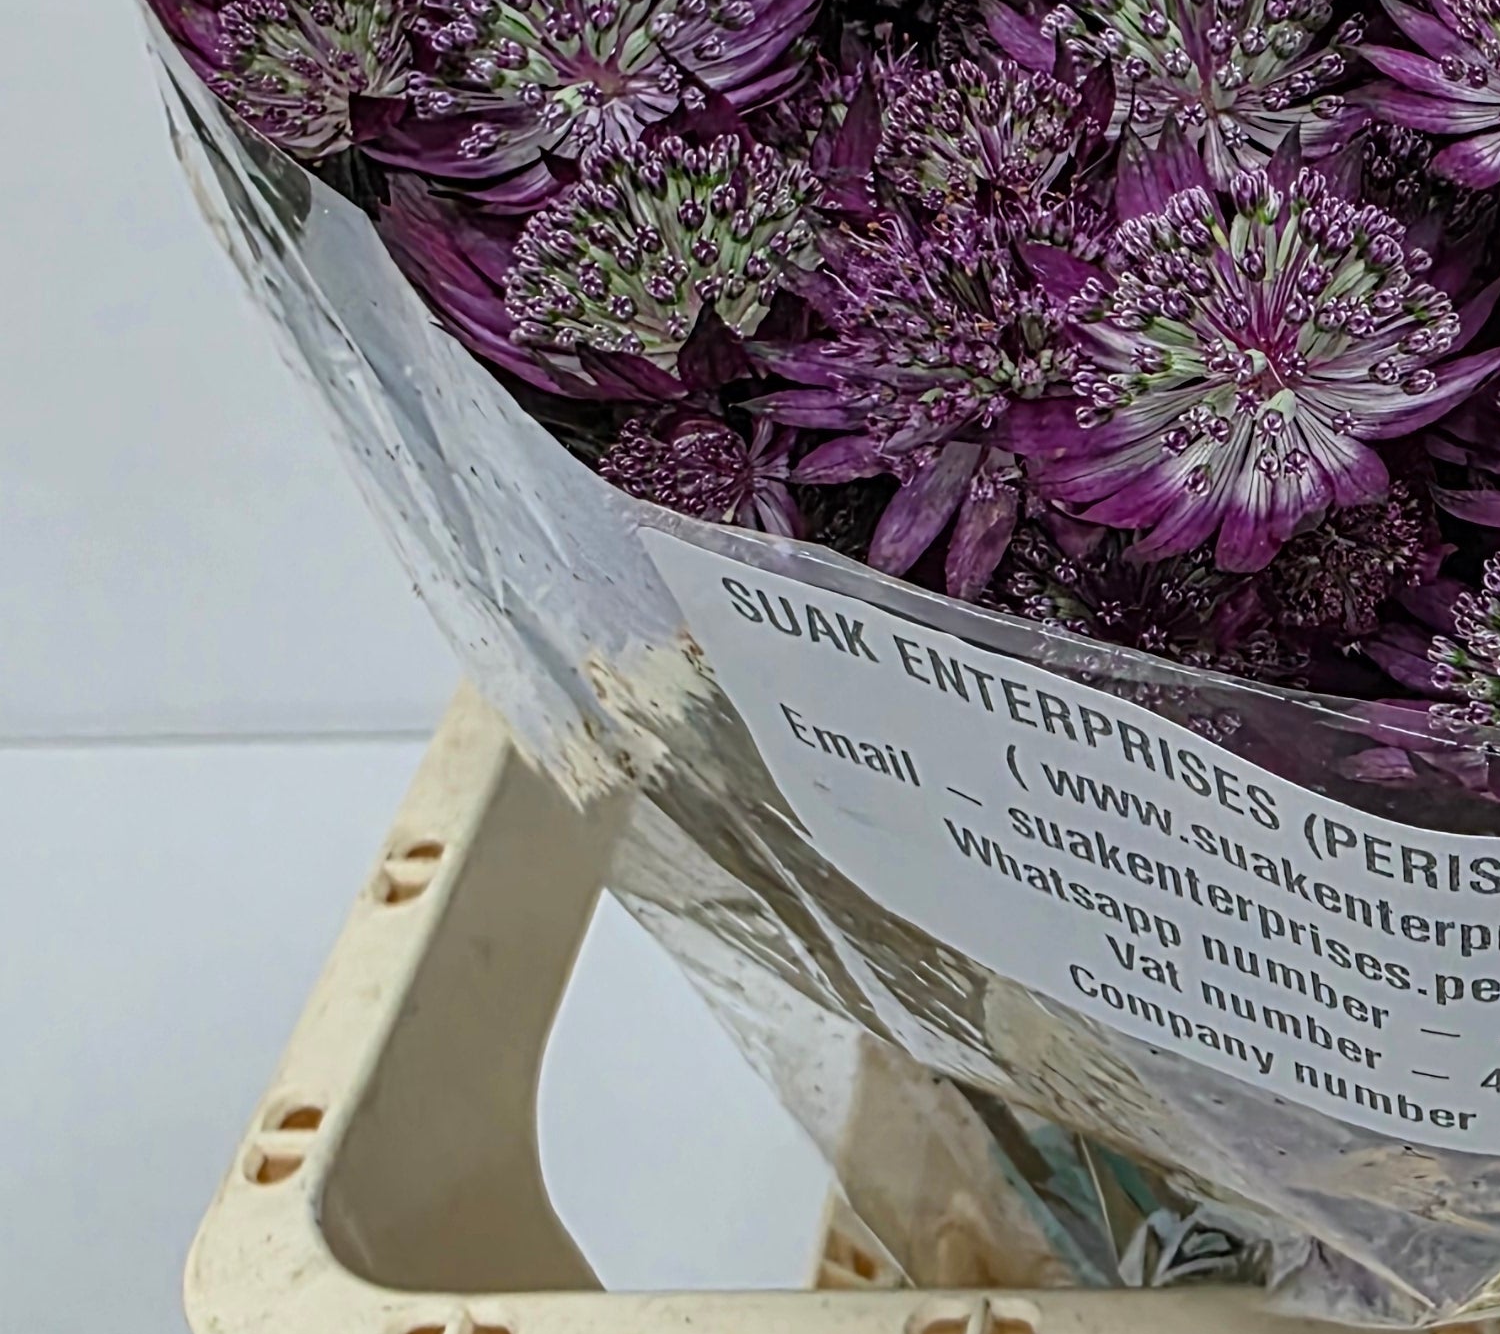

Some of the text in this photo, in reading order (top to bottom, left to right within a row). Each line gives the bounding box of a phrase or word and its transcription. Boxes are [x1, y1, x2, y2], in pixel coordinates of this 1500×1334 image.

[721, 576, 877, 663] SUAK
[892, 637, 1282, 832] ENTERPRISES
[779, 703, 921, 788] Email
[944, 818, 1183, 949] Whatsapp
[1203, 933, 1390, 1032] number
[1106, 934, 1182, 993] Vat
[1203, 981, 1383, 1070] number
[1070, 965, 1275, 1075] Company
[1294, 1059, 1476, 1132] number
